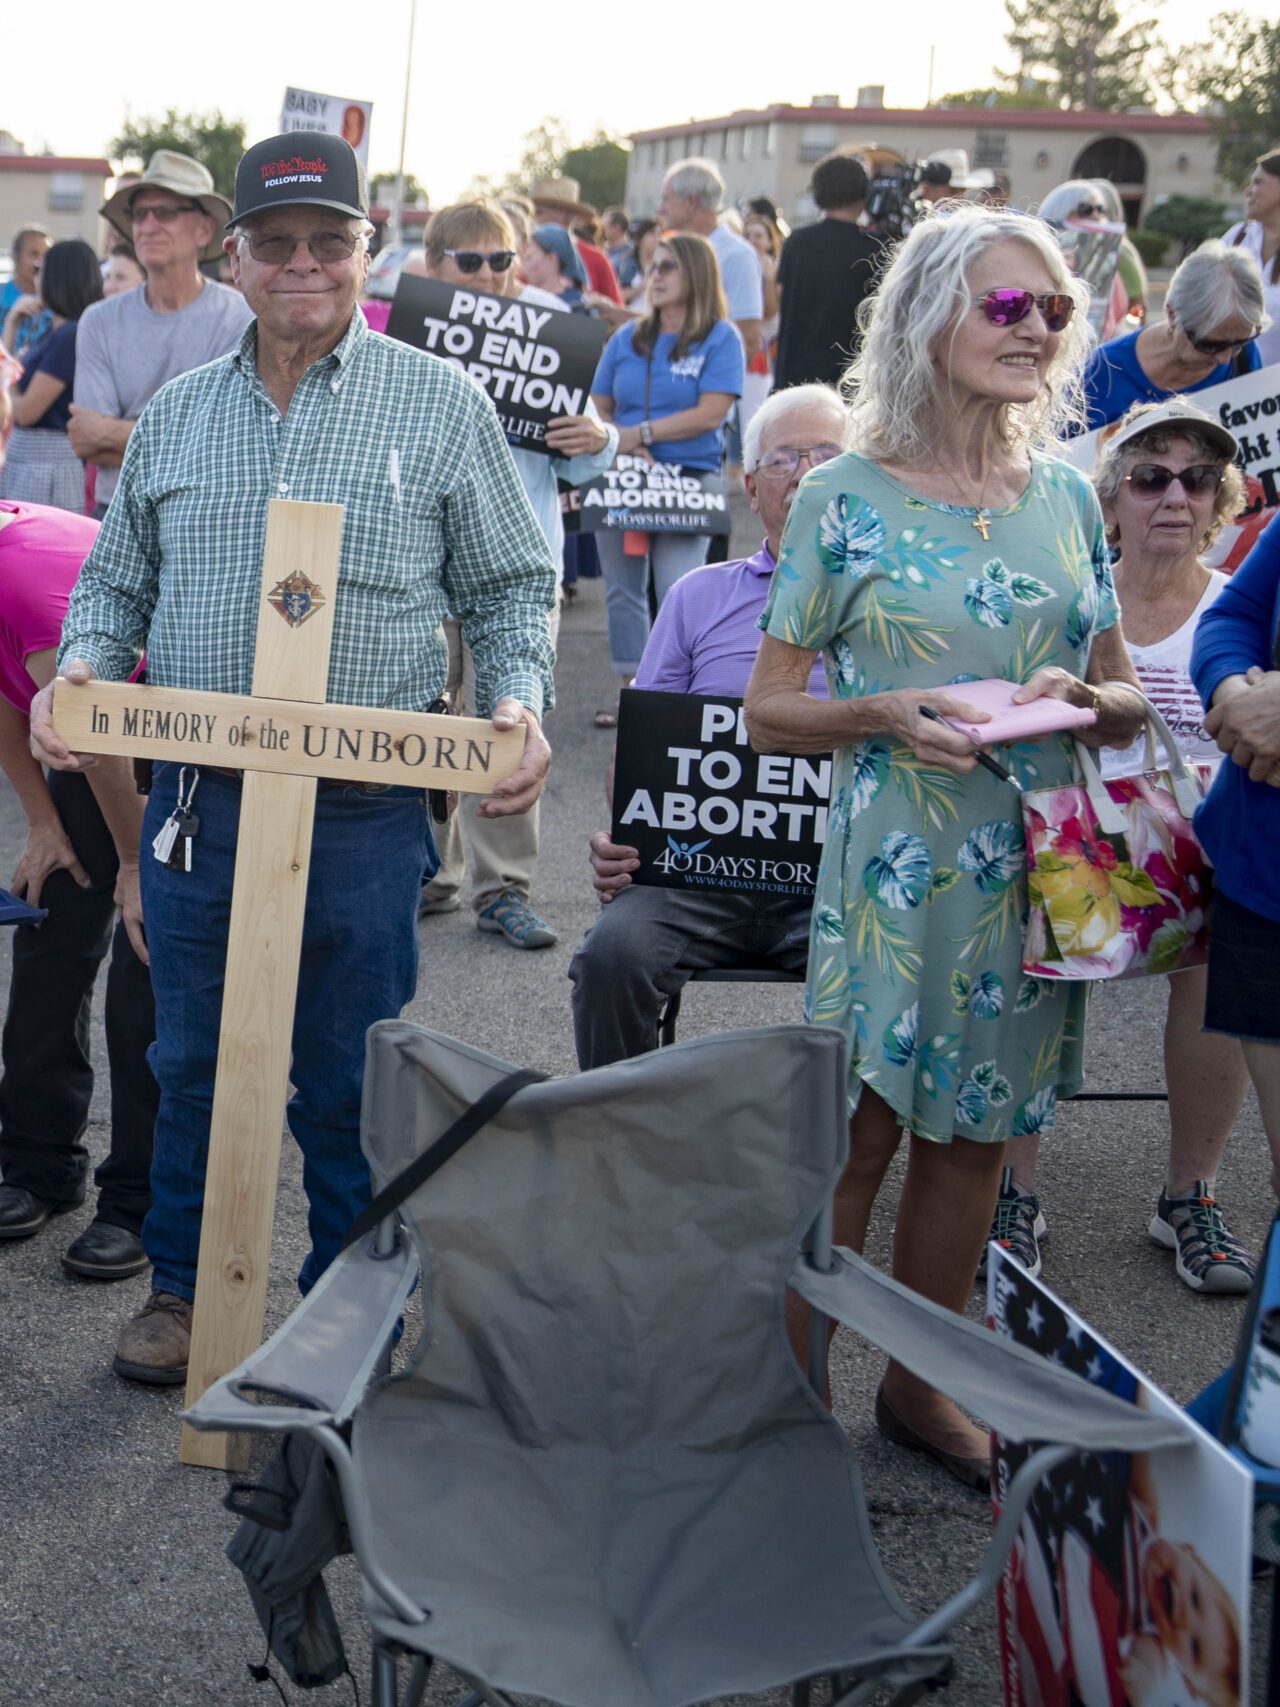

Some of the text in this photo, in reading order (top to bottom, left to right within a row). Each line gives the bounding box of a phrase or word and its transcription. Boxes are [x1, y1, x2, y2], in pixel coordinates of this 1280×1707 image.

[265, 174, 322, 188] FOLLOW JESUS
[449, 289, 552, 339] PRAY
[423, 316, 561, 376] TO END
[1219, 393, 1280, 429] favo
[603, 470, 701, 492] TO END
[616, 454, 683, 477] PRAY
[583, 487, 726, 511] ABORTION
[90, 704, 496, 773] In MEMORY of the UNBORN
[668, 747, 832, 799] TO EN
[620, 788, 828, 844] ABORTI
[653, 847, 815, 885] 40 DAYS FOR
